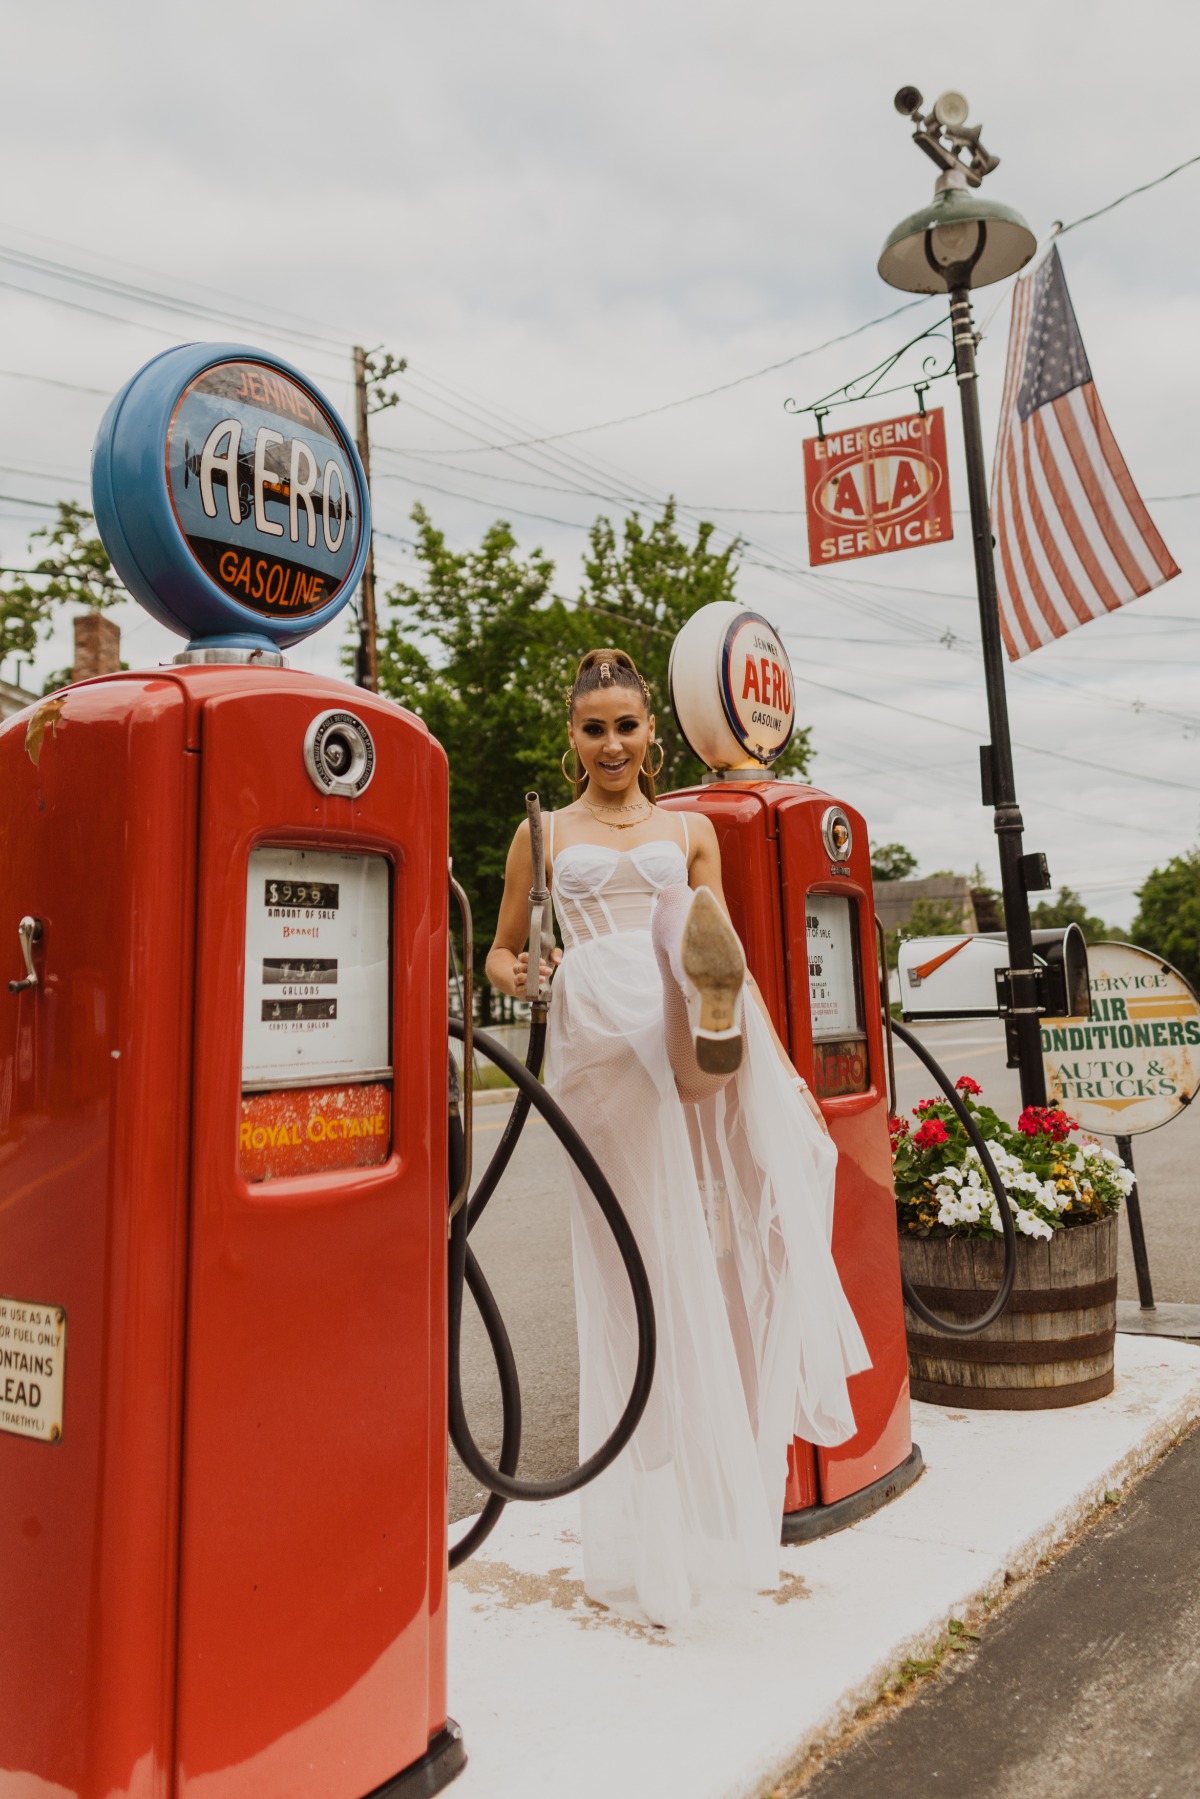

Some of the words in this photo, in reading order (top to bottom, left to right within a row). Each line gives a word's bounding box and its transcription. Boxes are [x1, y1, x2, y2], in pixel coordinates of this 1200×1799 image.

[236, 372, 317, 425] JENNEY
[814, 414, 935, 460] EMERGENCY
[199, 418, 347, 553] AERO
[833, 460, 924, 517] ALA
[820, 517, 942, 559] SERVICE
[219, 551, 325, 607] GASOLINE
[742, 653, 791, 715] AERO
[752, 710, 782, 732] GASOLINE
[267, 908, 301, 918] AMOUNT
[305, 909, 314, 919] OF
[318, 910, 336, 920] SALE
[282, 986, 320, 996] GALLONS
[1087, 997, 1128, 1023] AIR
[269, 1022, 288, 1032] CENTS
[292, 1022, 303, 1031] PER
[307, 1021, 330, 1030] GALLON
[814, 1054, 864, 1089] AERO
[1055, 1060, 1134, 1080] AUTO
[1146, 1060, 1167, 1077] &
[1054, 1078, 1177, 1099] TRUCKS
[240, 1121, 302, 1150] ROYAL
[307, 1115, 385, 1142] OCTANE
[10, 1308, 27, 1323] USE
[29, 1311, 41, 1325] AS
[44, 1314, 51, 1326] A
[13, 1328, 35, 1344] FUEL
[37, 1332, 61, 1348] ONLY
